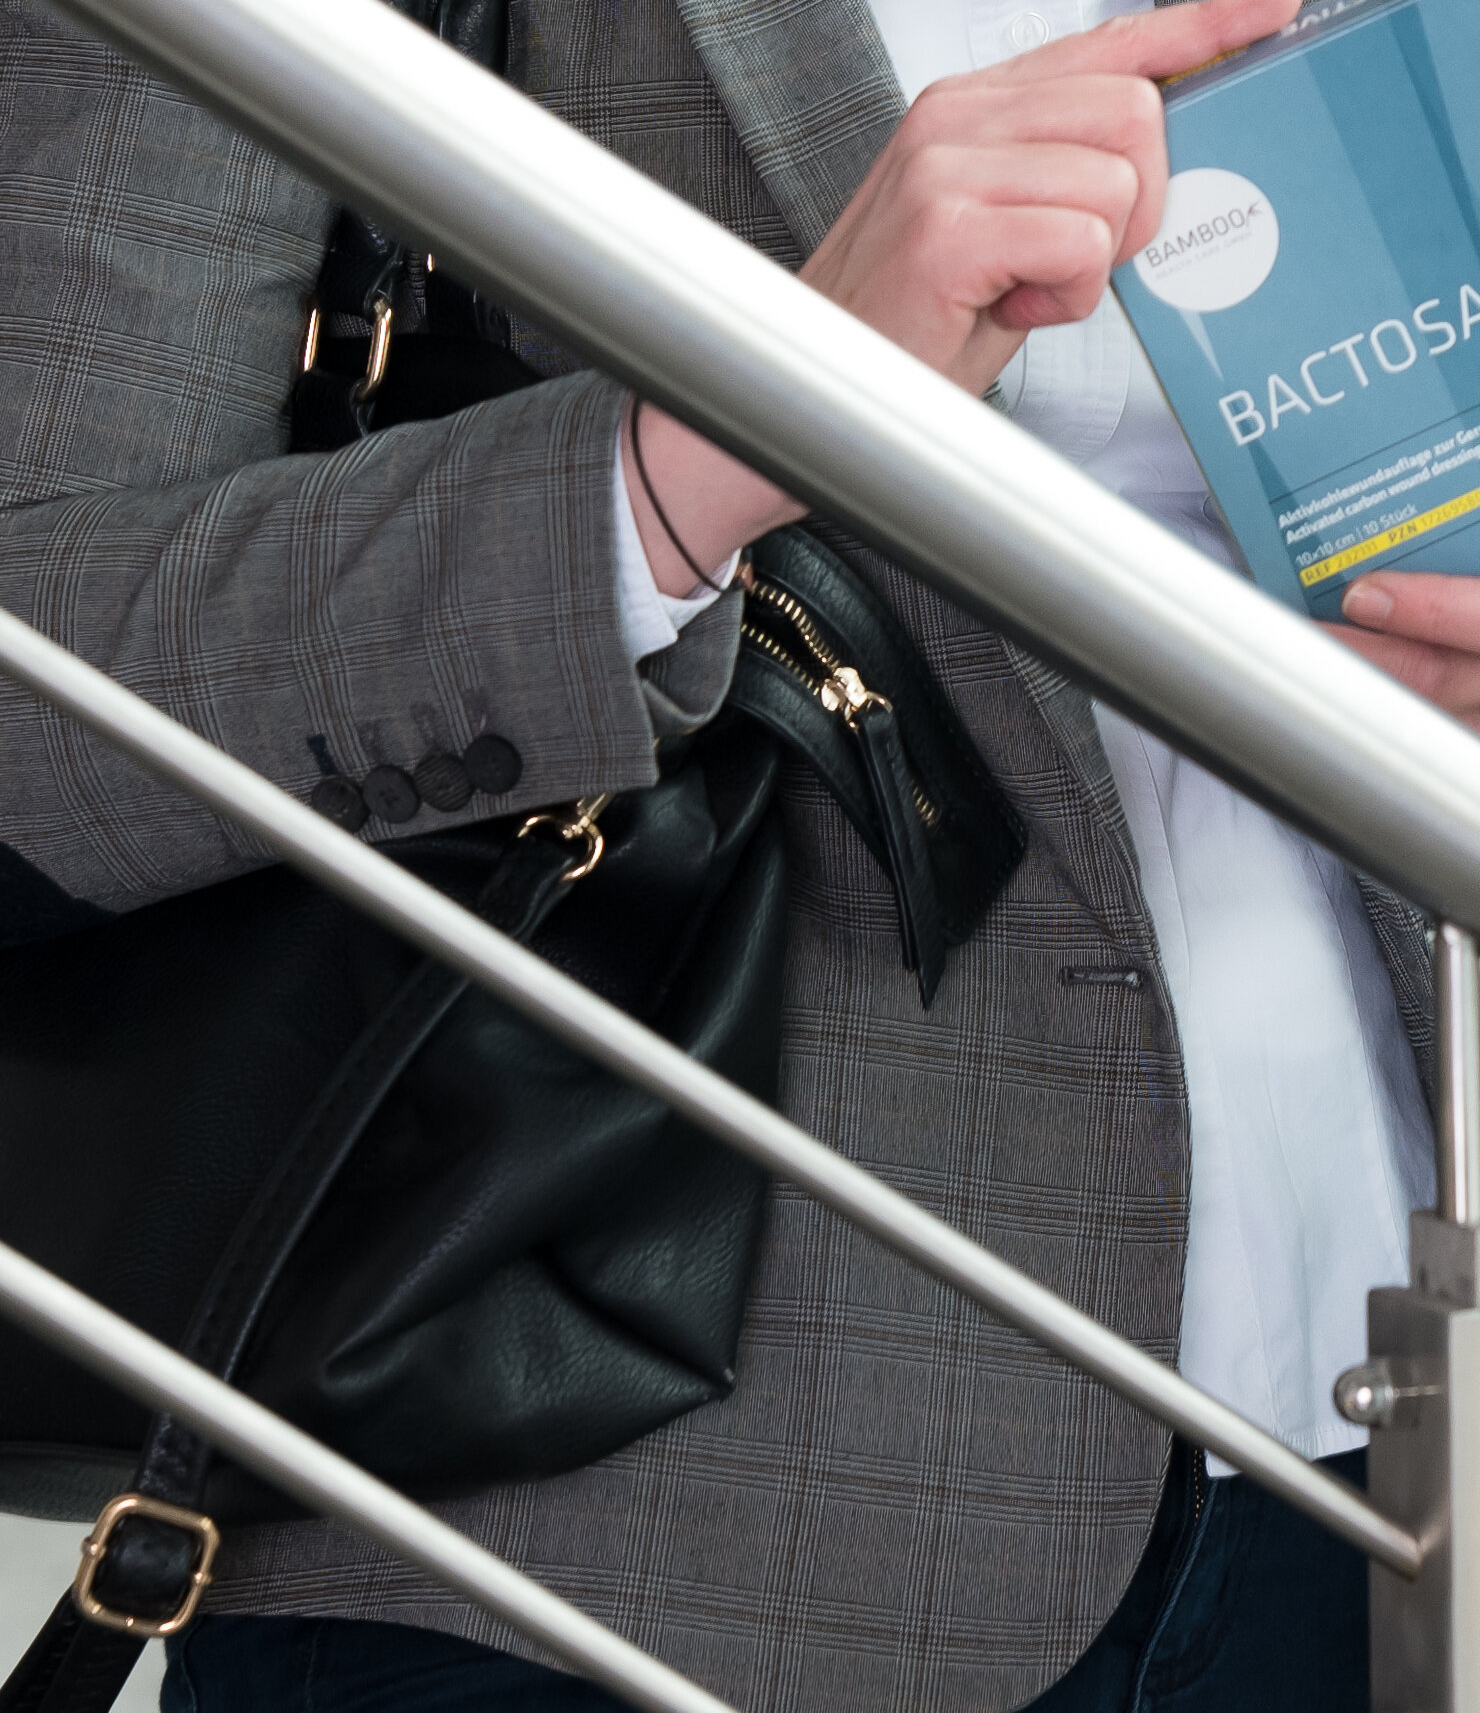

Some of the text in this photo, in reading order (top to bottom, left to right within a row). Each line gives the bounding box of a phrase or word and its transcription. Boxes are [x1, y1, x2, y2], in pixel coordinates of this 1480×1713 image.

[1145, 208, 1247, 268] BAMBOO
[1278, 448, 1433, 529] Aktivkohlewundauflage
[1434, 437, 1455, 457] zur
[1286, 506, 1346, 545] Activated
[1345, 489, 1388, 517] carbon
[1388, 466, 1432, 496] wound
[1305, 562, 1332, 584] REF
[1387, 522, 1418, 544] PZN
[1335, 533, 1356, 551] cm
[1363, 520, 1379, 537] 10
[1379, 503, 1419, 529] Stück
